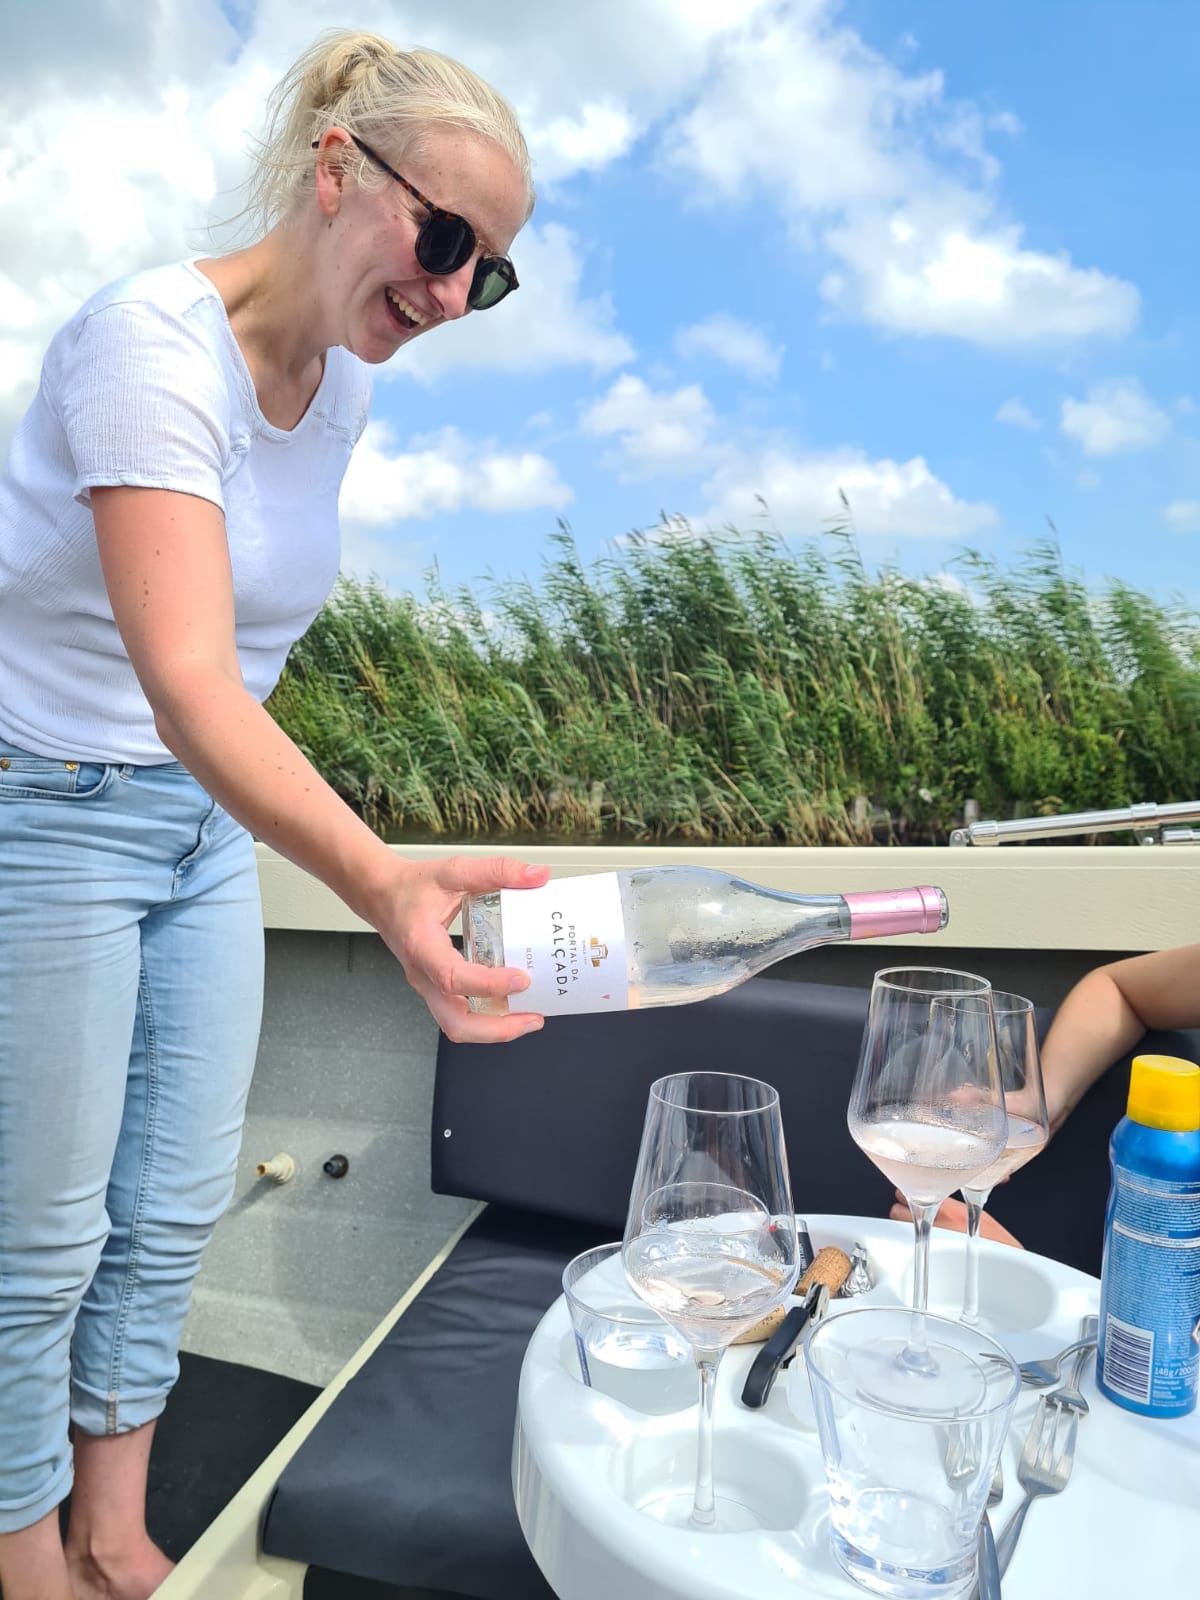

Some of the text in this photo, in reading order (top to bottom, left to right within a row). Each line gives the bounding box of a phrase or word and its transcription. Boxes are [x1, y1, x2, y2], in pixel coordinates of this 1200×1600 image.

[551, 911, 569, 996] CALÇADA
[568, 925, 579, 982] PORTAL DA
